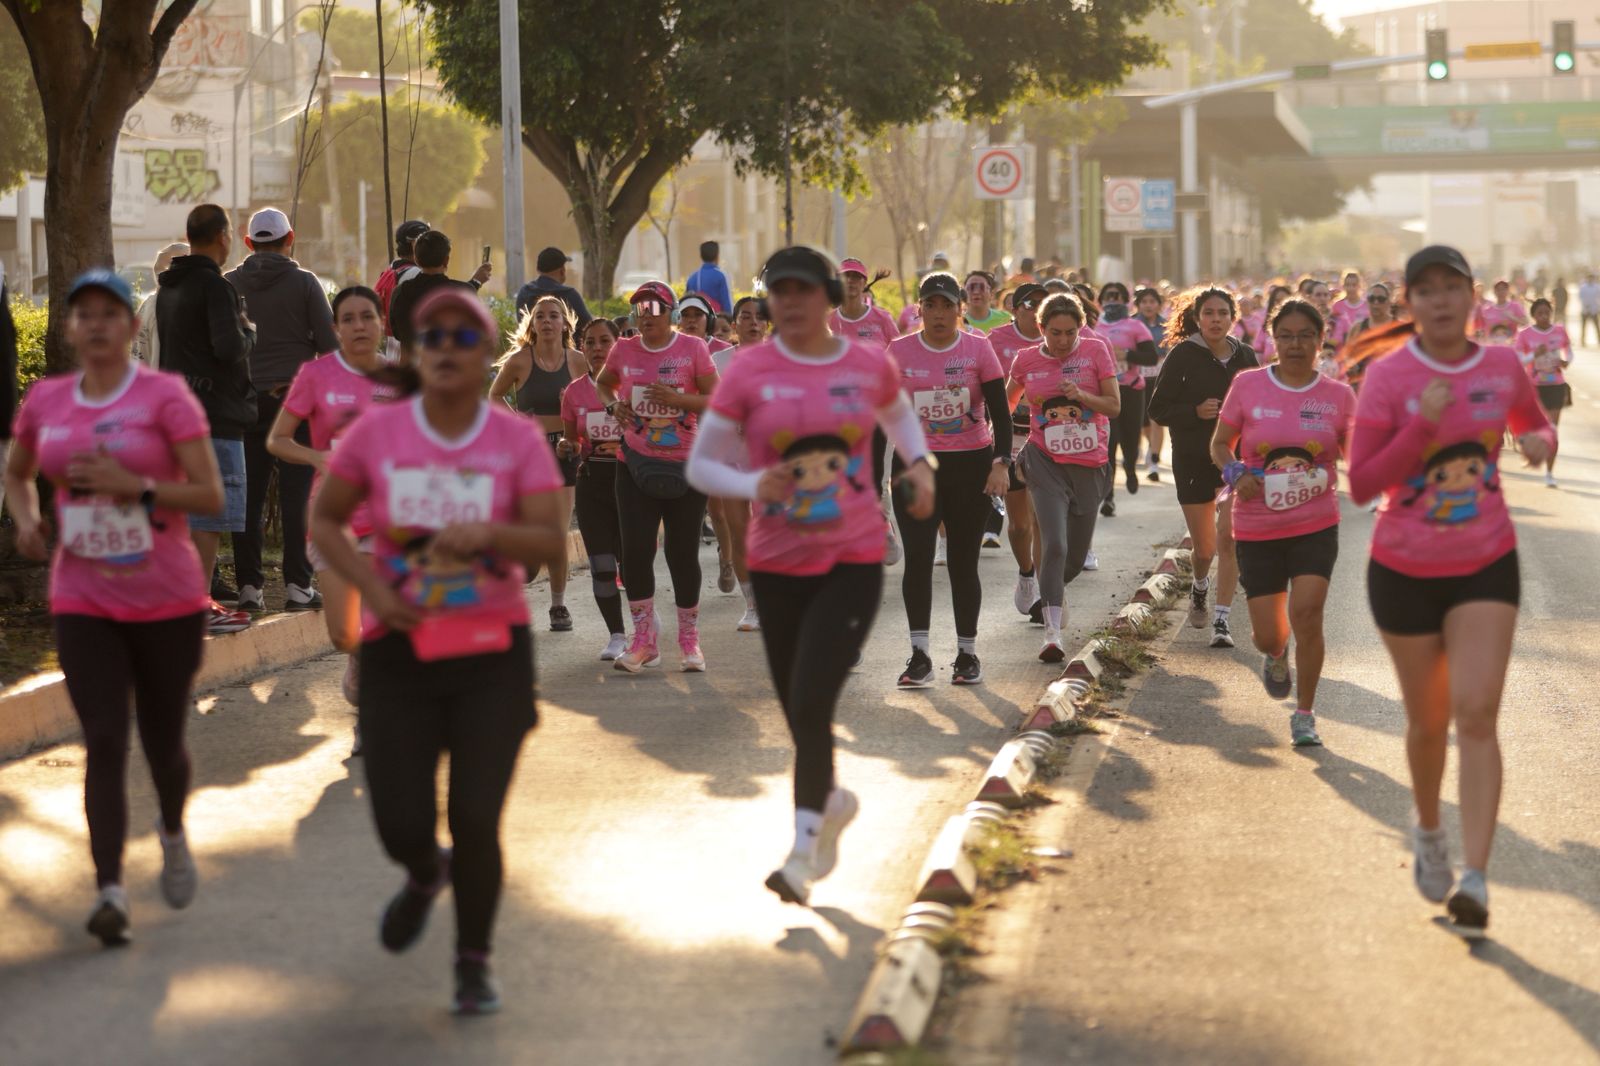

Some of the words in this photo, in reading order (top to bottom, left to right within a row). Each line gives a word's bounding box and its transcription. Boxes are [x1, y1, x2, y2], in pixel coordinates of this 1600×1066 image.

[988, 161, 1011, 177] 40
[919, 402, 964, 418] 3561
[590, 425, 623, 438] 384
[1050, 437, 1094, 452] 5060
[1270, 485, 1322, 507] 2689
[71, 528, 144, 553] 4585
